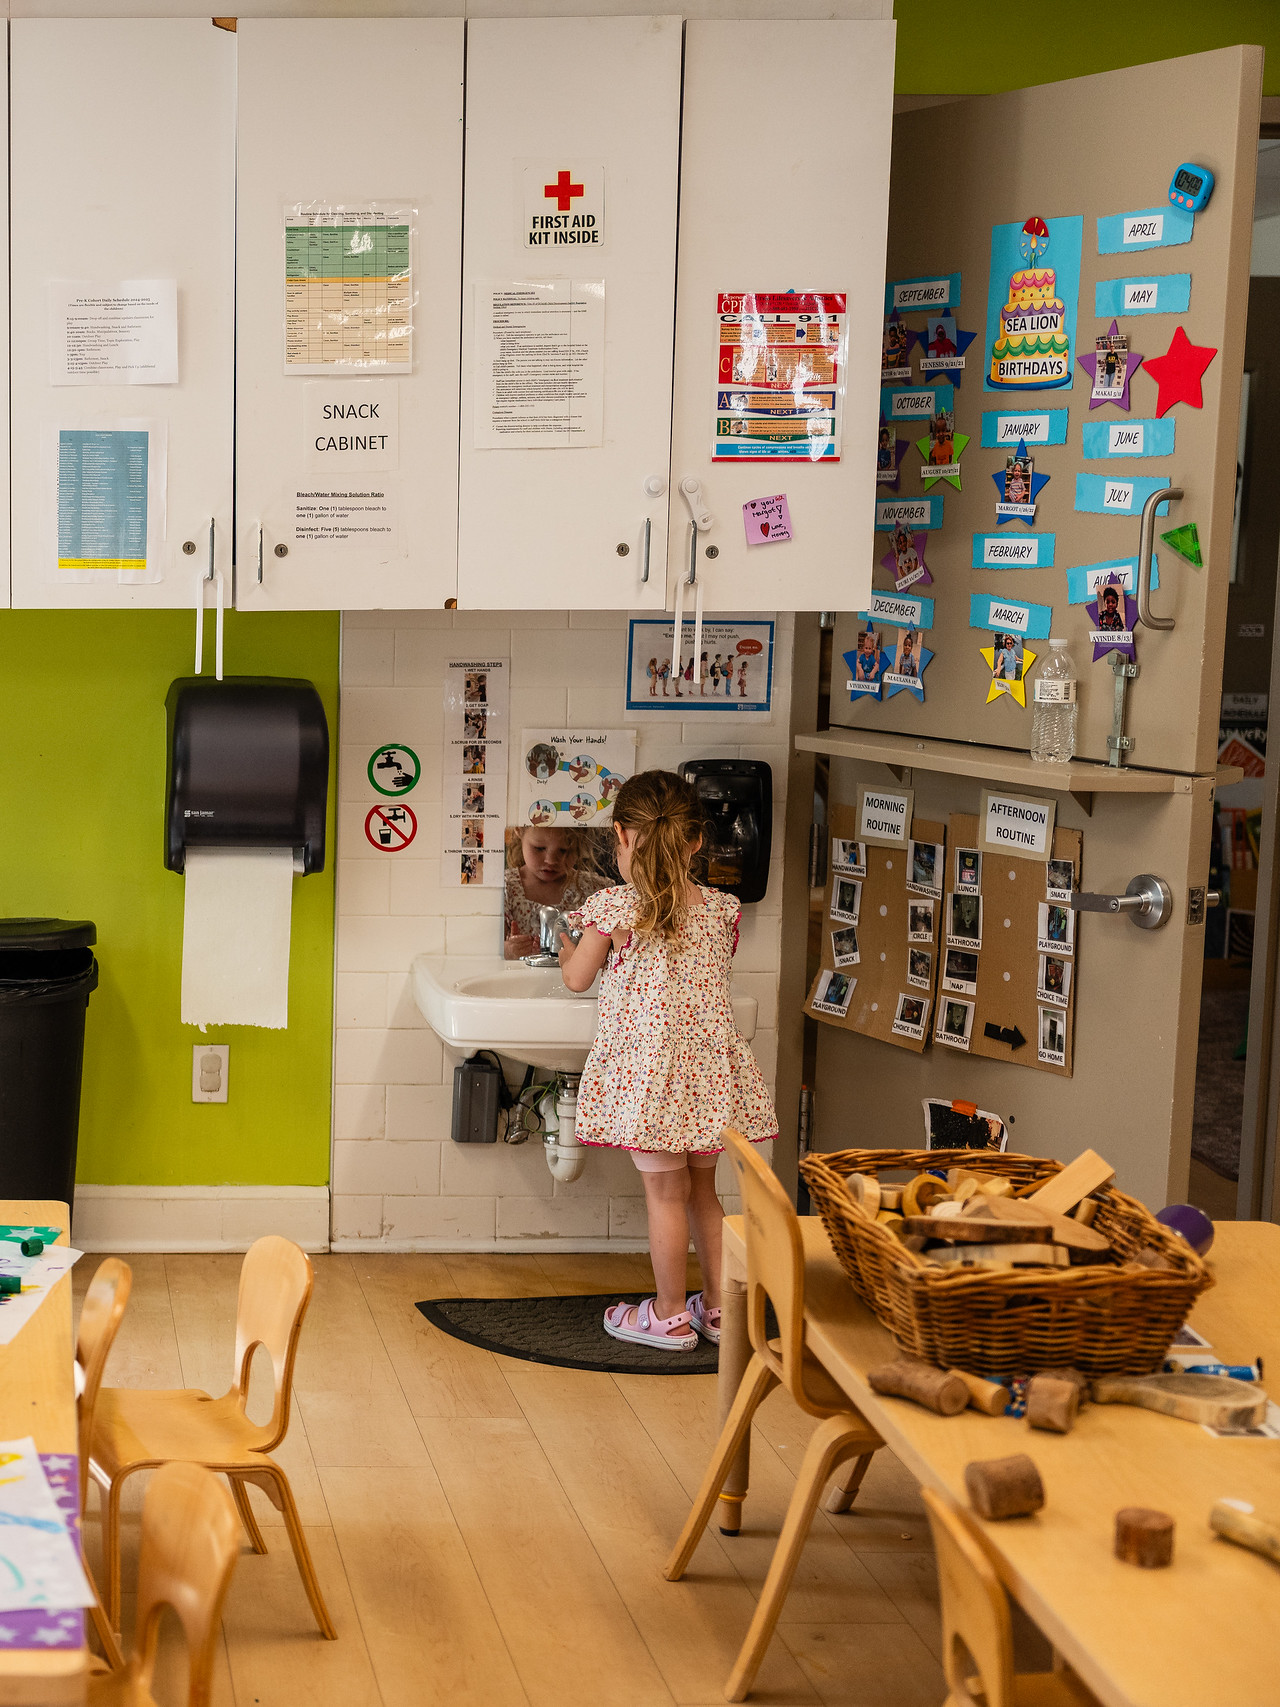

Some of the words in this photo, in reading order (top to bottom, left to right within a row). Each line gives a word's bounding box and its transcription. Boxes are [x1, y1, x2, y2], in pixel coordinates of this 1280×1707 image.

[533, 216, 569, 228] FIRST
[572, 215, 595, 227] AID
[1128, 223, 1156, 237] APRIL
[529, 232, 550, 244] KIT
[554, 231, 598, 244] INSIDE
[899, 288, 945, 302] SEPTEMBER
[1130, 290, 1153, 303] MAY
[1007, 318, 1027, 332] SEA
[1031, 315, 1058, 329] LION
[999, 361, 1062, 375] BIRTHDAYS
[719, 392, 730, 408] A
[897, 397, 932, 409] OCTOBER
[323, 404, 380, 419] SNACK
[718, 420, 730, 435] B
[1002, 423, 1040, 438] JANUARY
[315, 436, 388, 451] CABINET
[1114, 432, 1139, 446] JUNE
[1107, 489, 1129, 503] JULY
[883, 507, 925, 519] NOVEMBER
[989, 546, 1032, 558] FEBRUARY
[874, 600, 916, 617] DECEMBER
[993, 608, 1024, 624] MARCH
[569, 735, 583, 744] Your
[586, 735, 607, 744] Hands!
[866, 797, 905, 814] MORNING
[990, 802, 1046, 824] AFTERNOON
[867, 819, 901, 835] ROUTINE
[996, 827, 1035, 845] ROUTINE
[832, 864, 865, 874] HANDWASHING
[907, 883, 940, 897] HANDWASHING
[958, 885, 977, 893] LUNCH
[1051, 891, 1066, 899] SNACK
[831, 910, 857, 921] BATHROOM
[947, 938, 980, 948] BATHROOM
[1039, 941, 1072, 952] PLAYGROUND
[840, 956, 855, 964] SNACK
[910, 977, 928, 987] ACTIVITY
[1037, 991, 1054, 1001] CHOICE
[1055, 995, 1067, 1005] TIME
[812, 1001, 846, 1015] PLAYGROUND
[893, 1022, 909, 1033] CHOICE
[911, 1027, 922, 1036] TIME
[936, 1033, 968, 1045] BATHROOM
[1048, 1052, 1063, 1062] HOME
